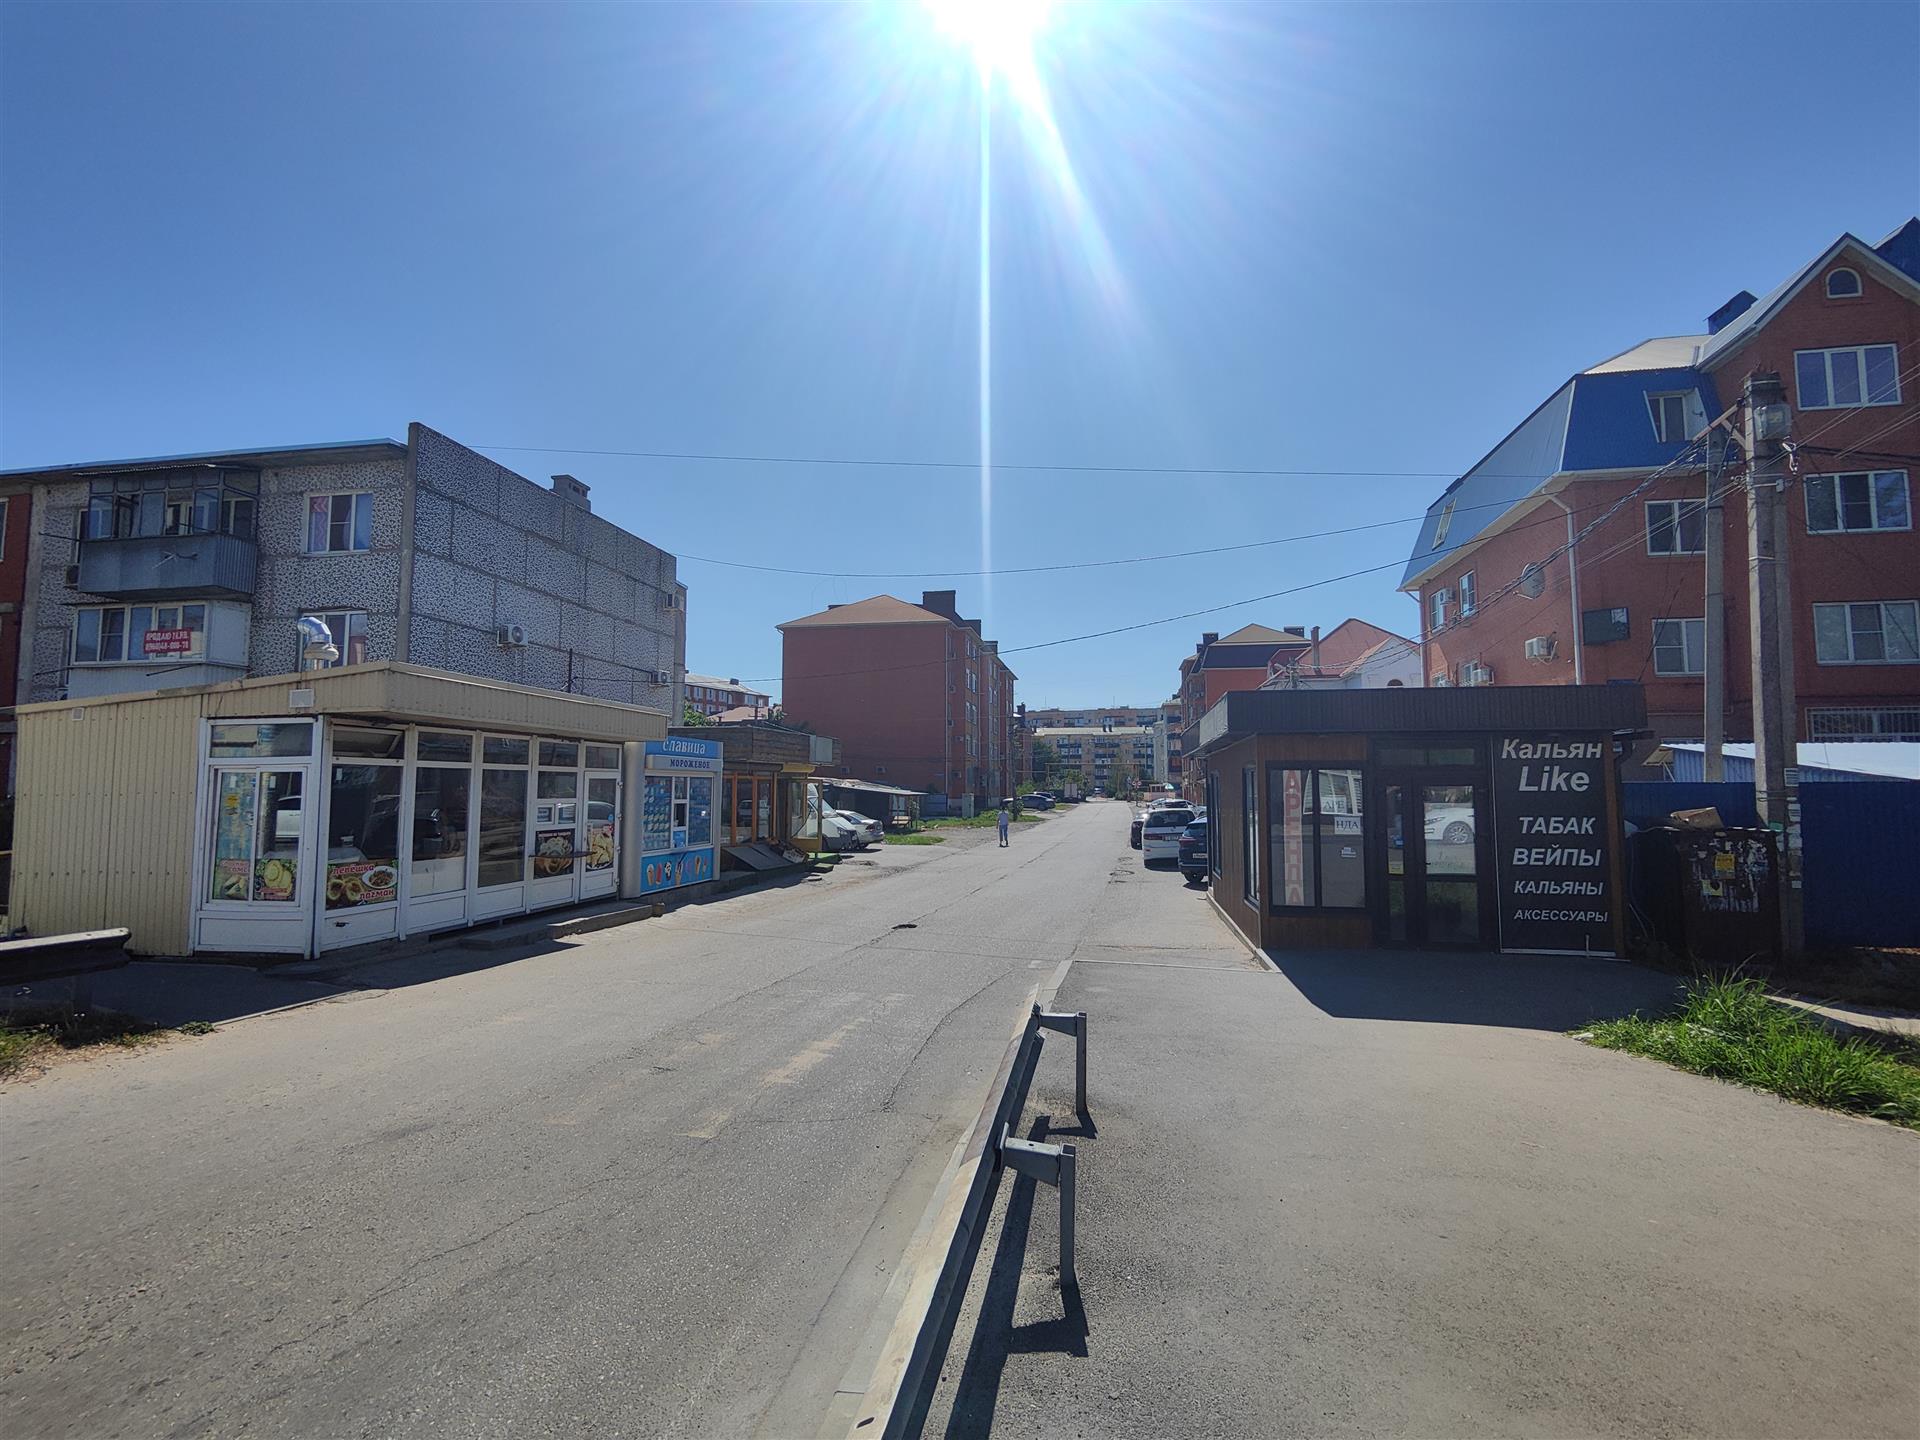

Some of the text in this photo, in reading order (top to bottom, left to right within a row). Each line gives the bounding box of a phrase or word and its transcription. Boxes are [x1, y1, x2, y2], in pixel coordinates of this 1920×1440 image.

[1501, 738, 1602, 759] Кальян
[670, 758, 711, 769] МОРОЖЕНОЕ
[1519, 765, 1590, 792] Like
[1335, 820, 1359, 829] НДА
[1519, 817, 1596, 835] ТАБАК
[1512, 844, 1601, 866] ВЕЙПЫ
[1513, 880, 1603, 895] КАЛЬЯНЫ
[1513, 909, 1608, 922] АКСЕССУАРЫ
